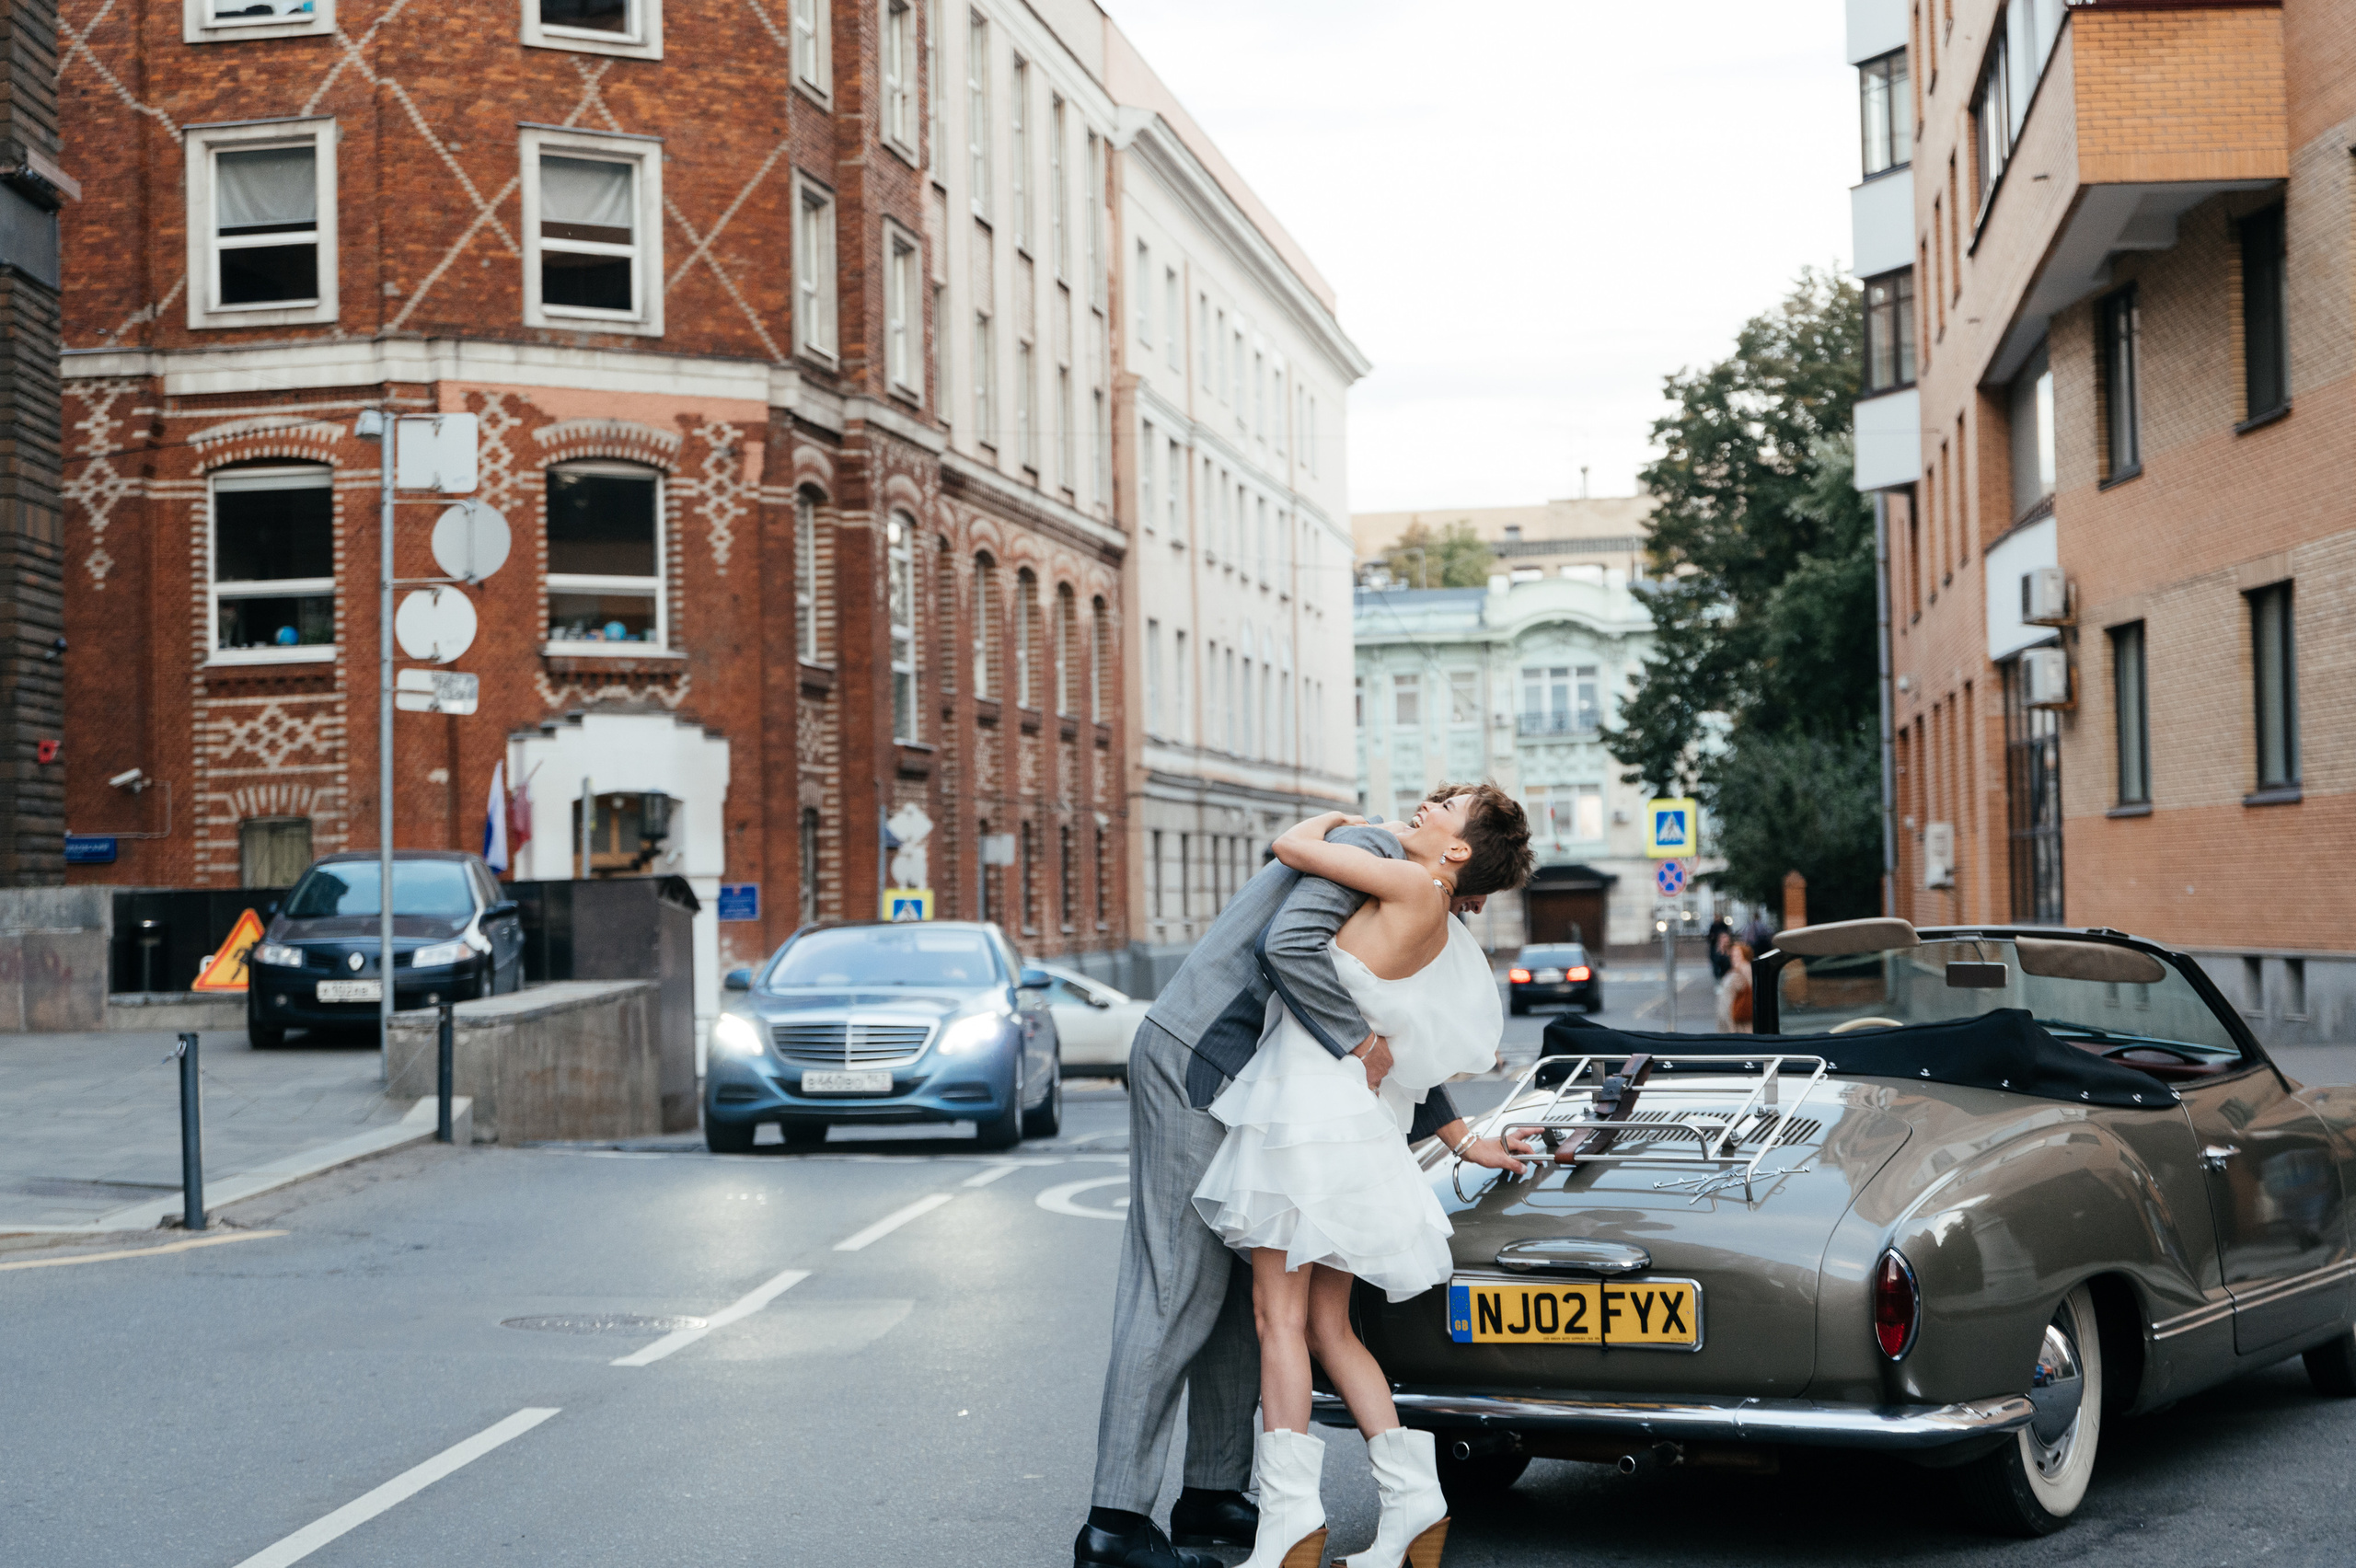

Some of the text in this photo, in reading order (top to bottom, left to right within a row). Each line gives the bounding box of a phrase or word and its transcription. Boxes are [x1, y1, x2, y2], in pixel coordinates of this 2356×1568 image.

[1653, 1165, 1810, 1189] KARMANN
[1477, 1291, 1687, 1334] NJ02 FYX
[1454, 1320, 1469, 1332] GB
